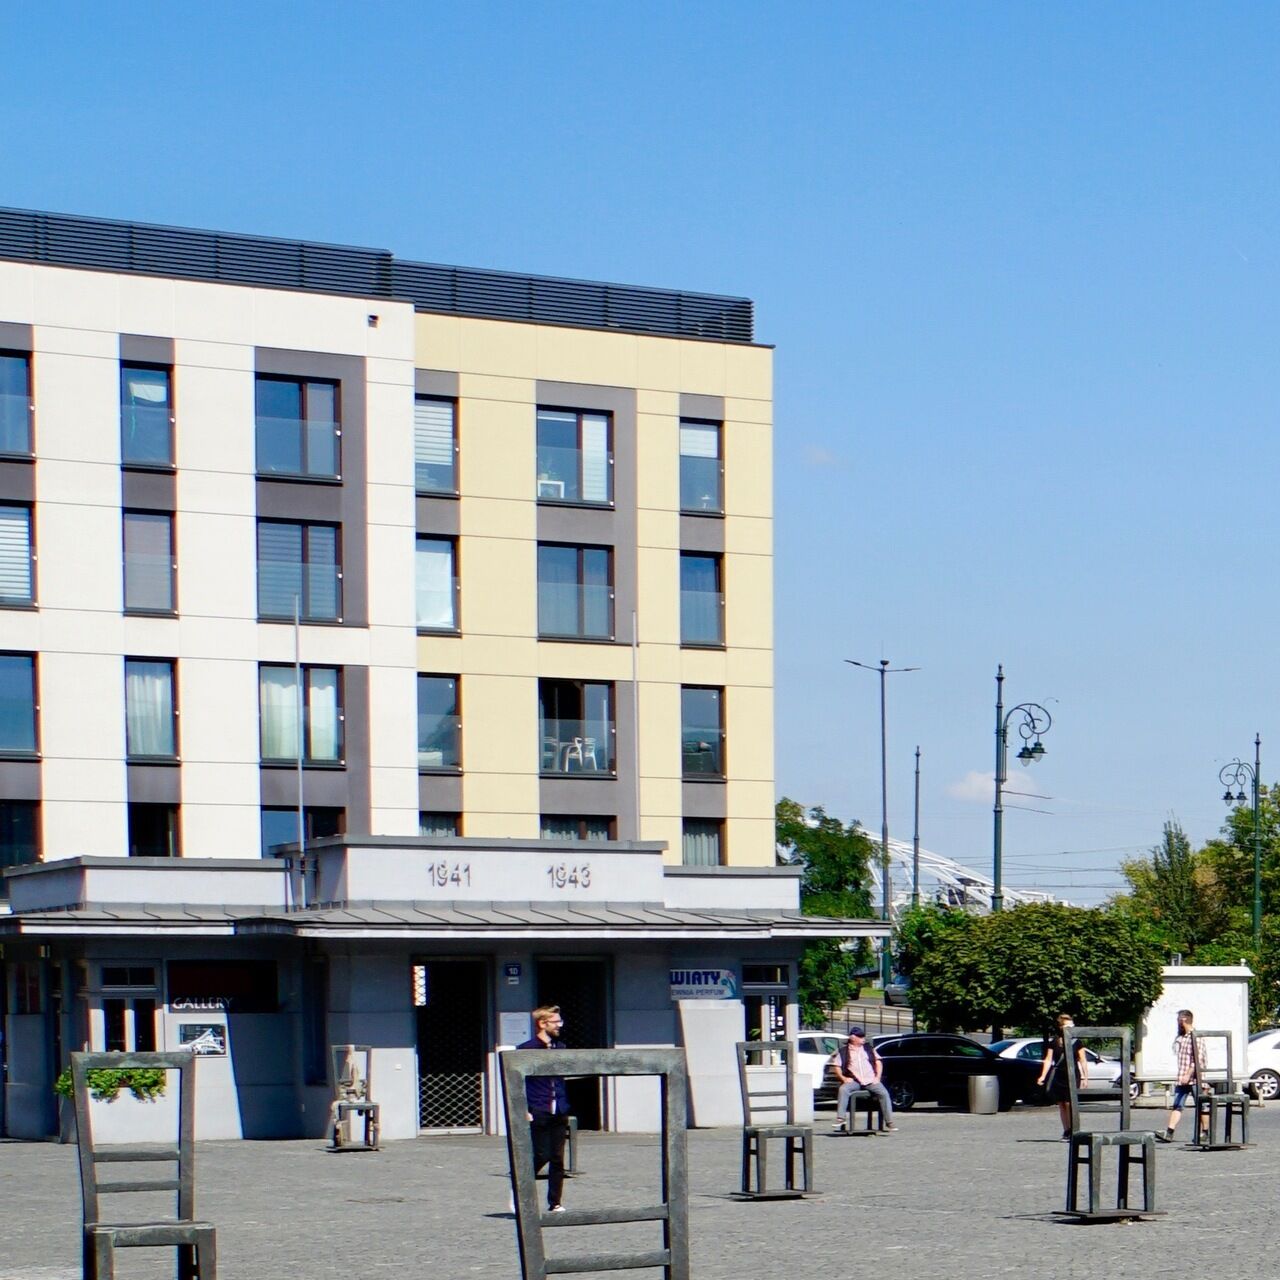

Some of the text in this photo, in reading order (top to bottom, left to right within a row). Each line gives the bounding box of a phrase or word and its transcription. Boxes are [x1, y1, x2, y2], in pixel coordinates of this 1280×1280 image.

[427, 862, 595, 888] 1941 1943
[173, 997, 233, 1009] GALLERY
